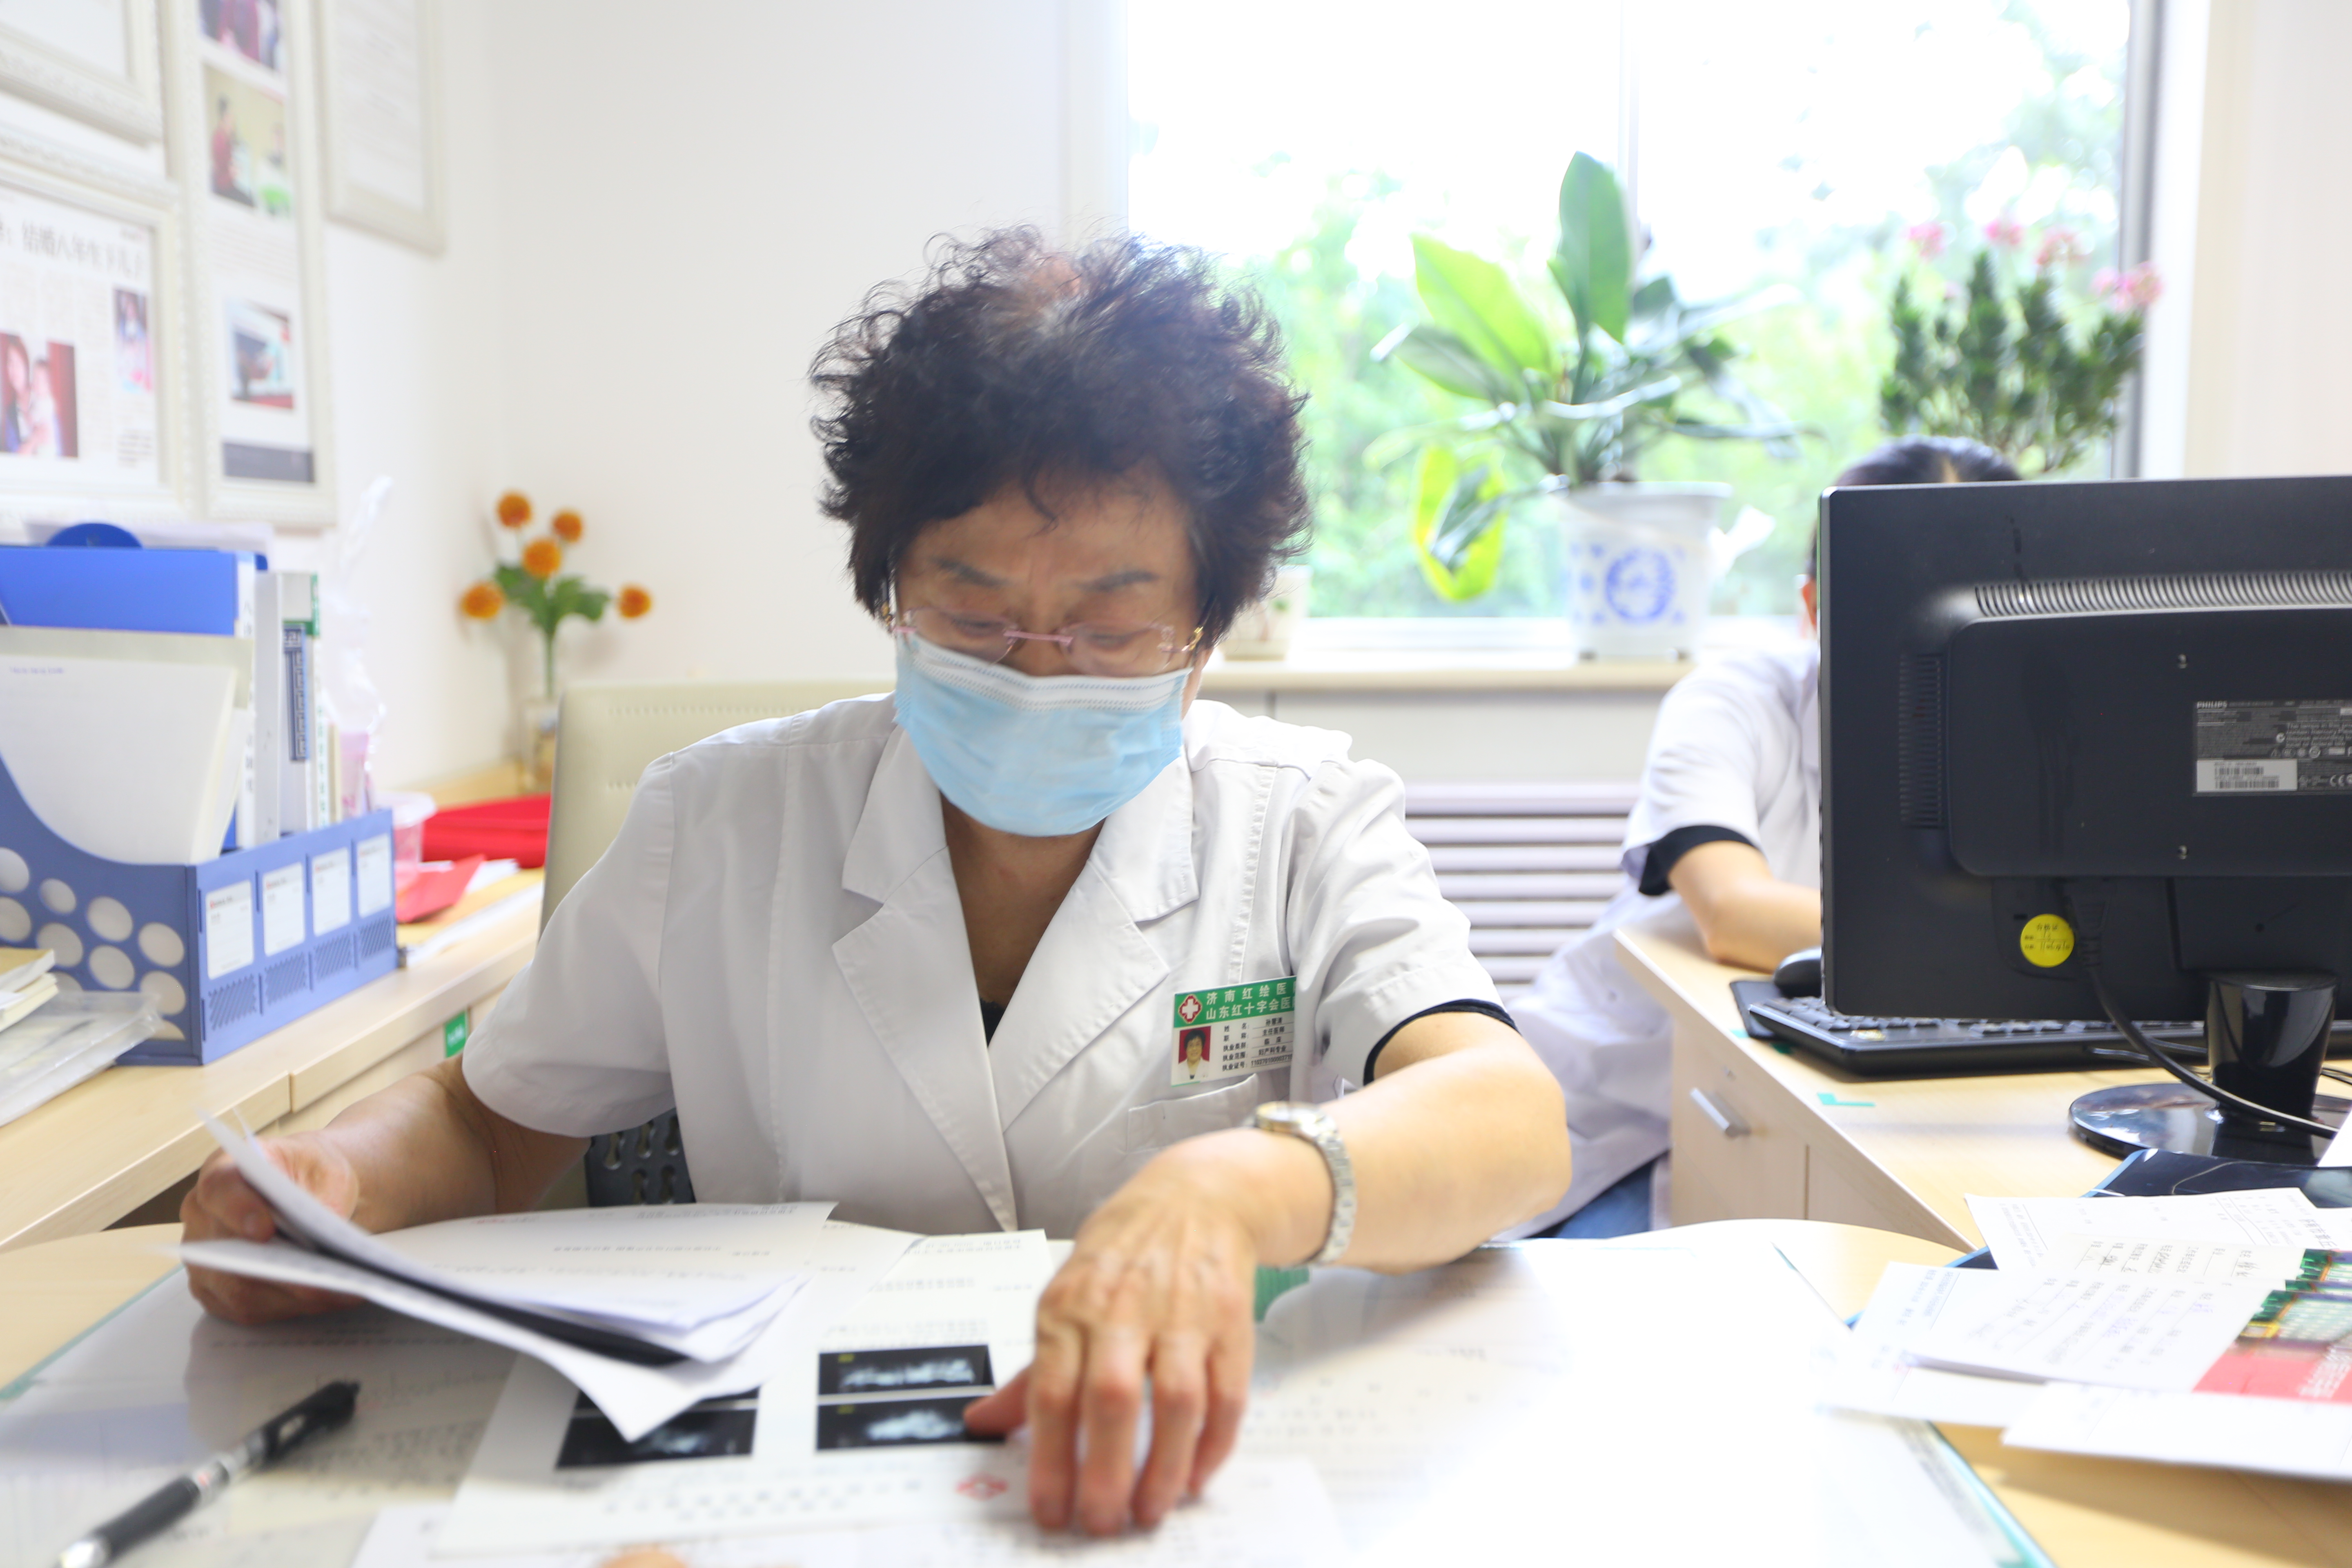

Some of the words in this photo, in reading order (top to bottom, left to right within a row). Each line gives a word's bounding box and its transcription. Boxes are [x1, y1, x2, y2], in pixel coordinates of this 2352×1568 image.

[1207, 980, 1296, 1005] 济南红绘医
[1206, 996, 1295, 1020] 山东红十字会医
